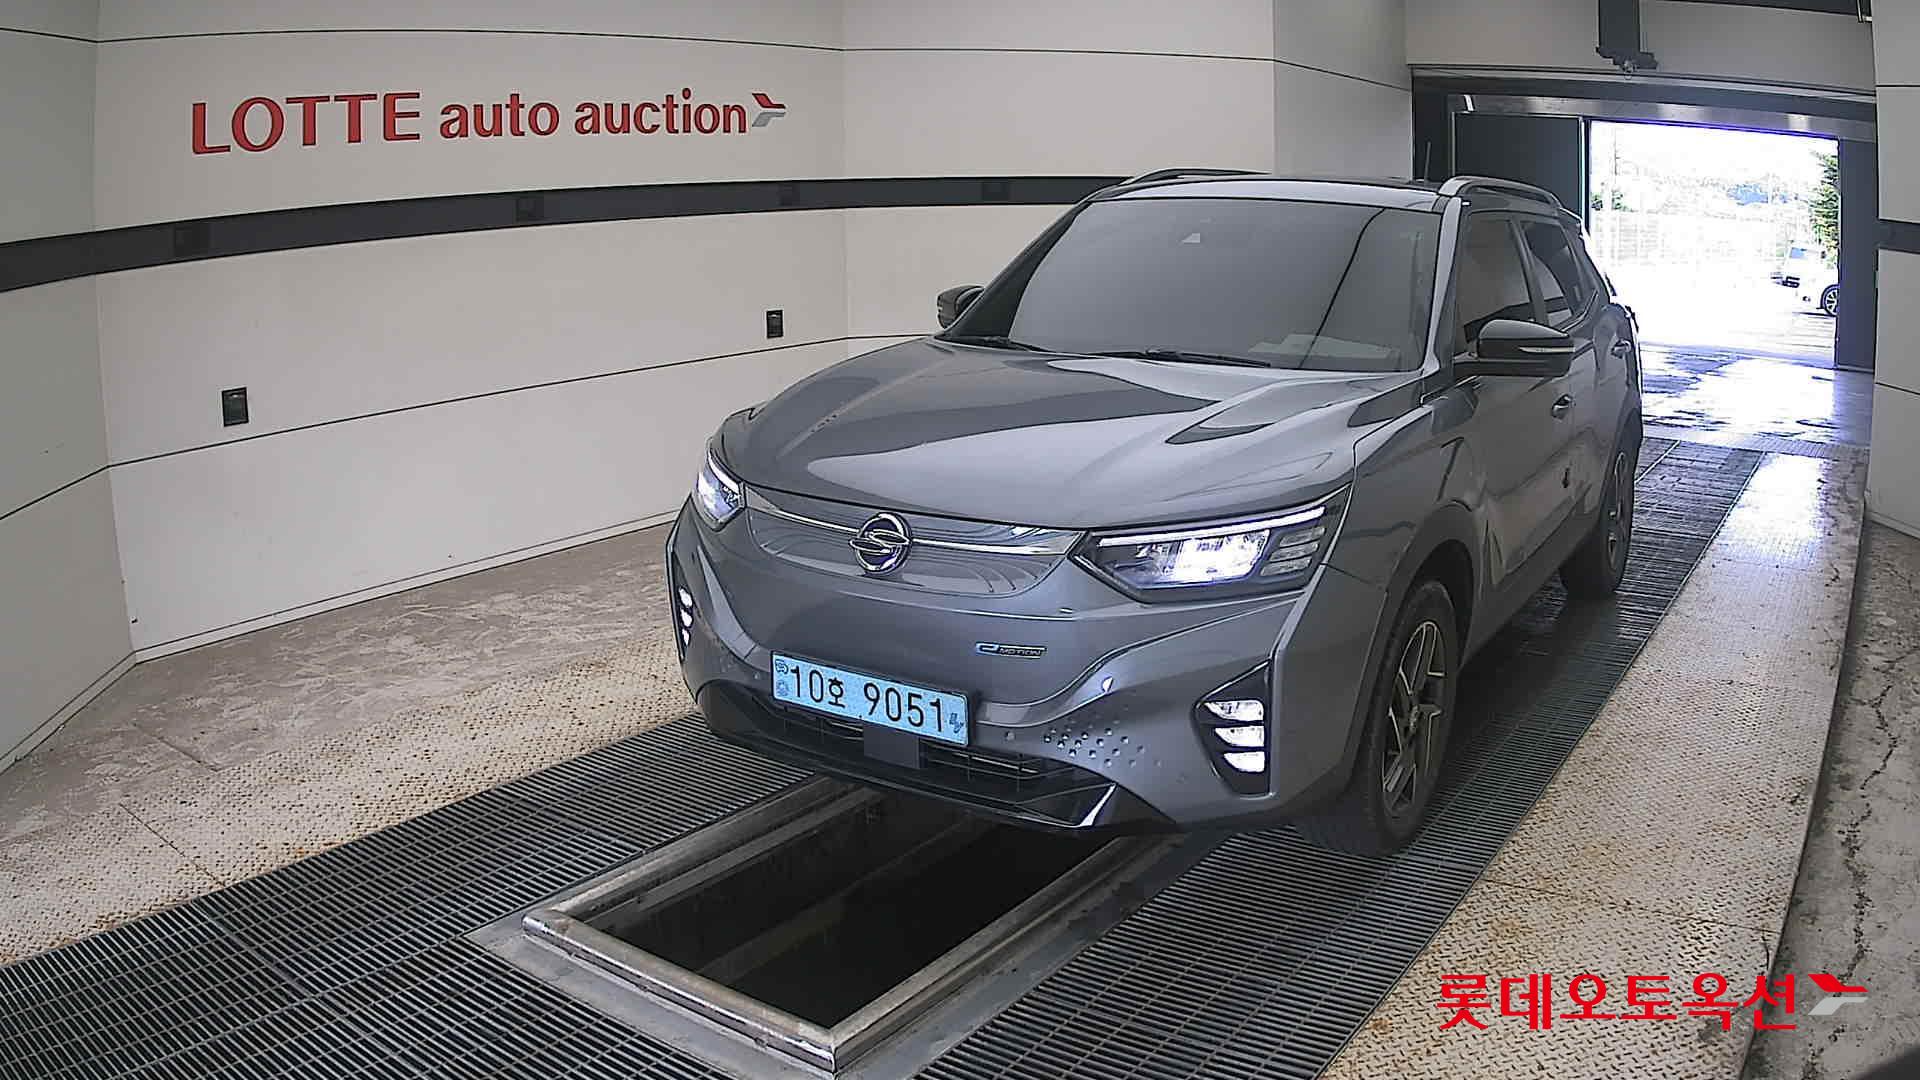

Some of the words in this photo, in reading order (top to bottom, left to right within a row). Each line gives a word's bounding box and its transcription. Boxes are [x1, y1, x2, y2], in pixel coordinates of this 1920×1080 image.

[192, 92, 420, 154] LOTTE
[440, 92, 560, 138] auto
[574, 88, 748, 135] auction
[790, 665, 846, 709] 10호
[863, 682, 943, 733] 9051
